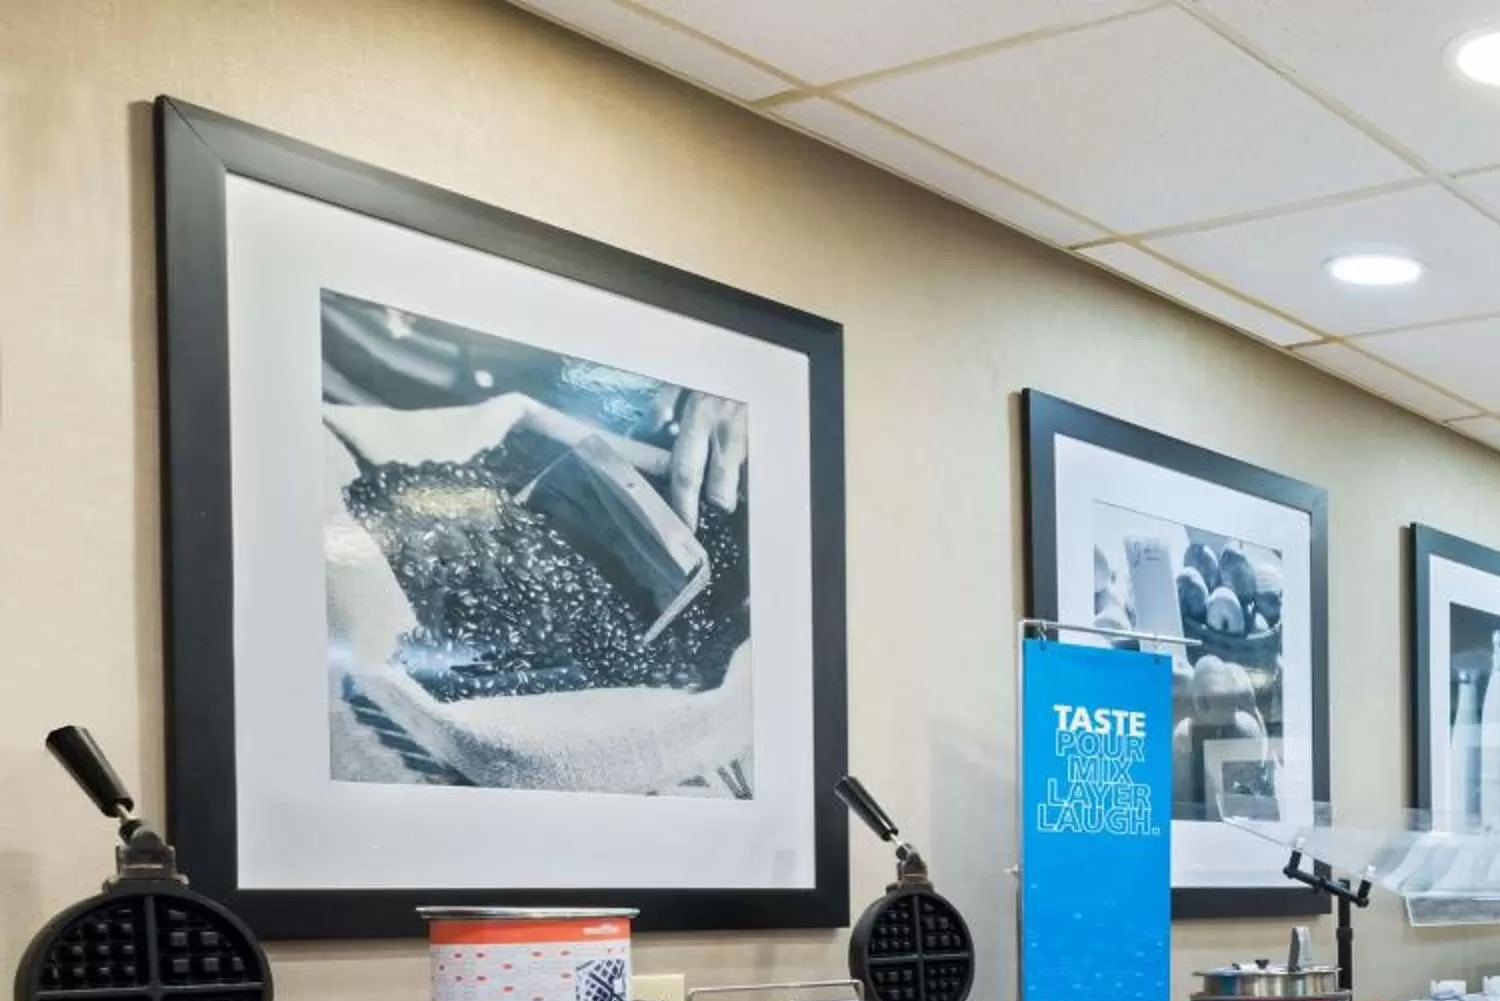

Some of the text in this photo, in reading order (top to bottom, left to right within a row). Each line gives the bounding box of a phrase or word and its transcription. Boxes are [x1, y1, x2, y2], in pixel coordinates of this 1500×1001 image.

[1053, 704, 1147, 737] TASTE
[1056, 729, 1145, 762] POUR
[1068, 755, 1134, 786] MIX
[1047, 778, 1151, 811] LAYER
[1037, 803, 1161, 835] LAUGH.
